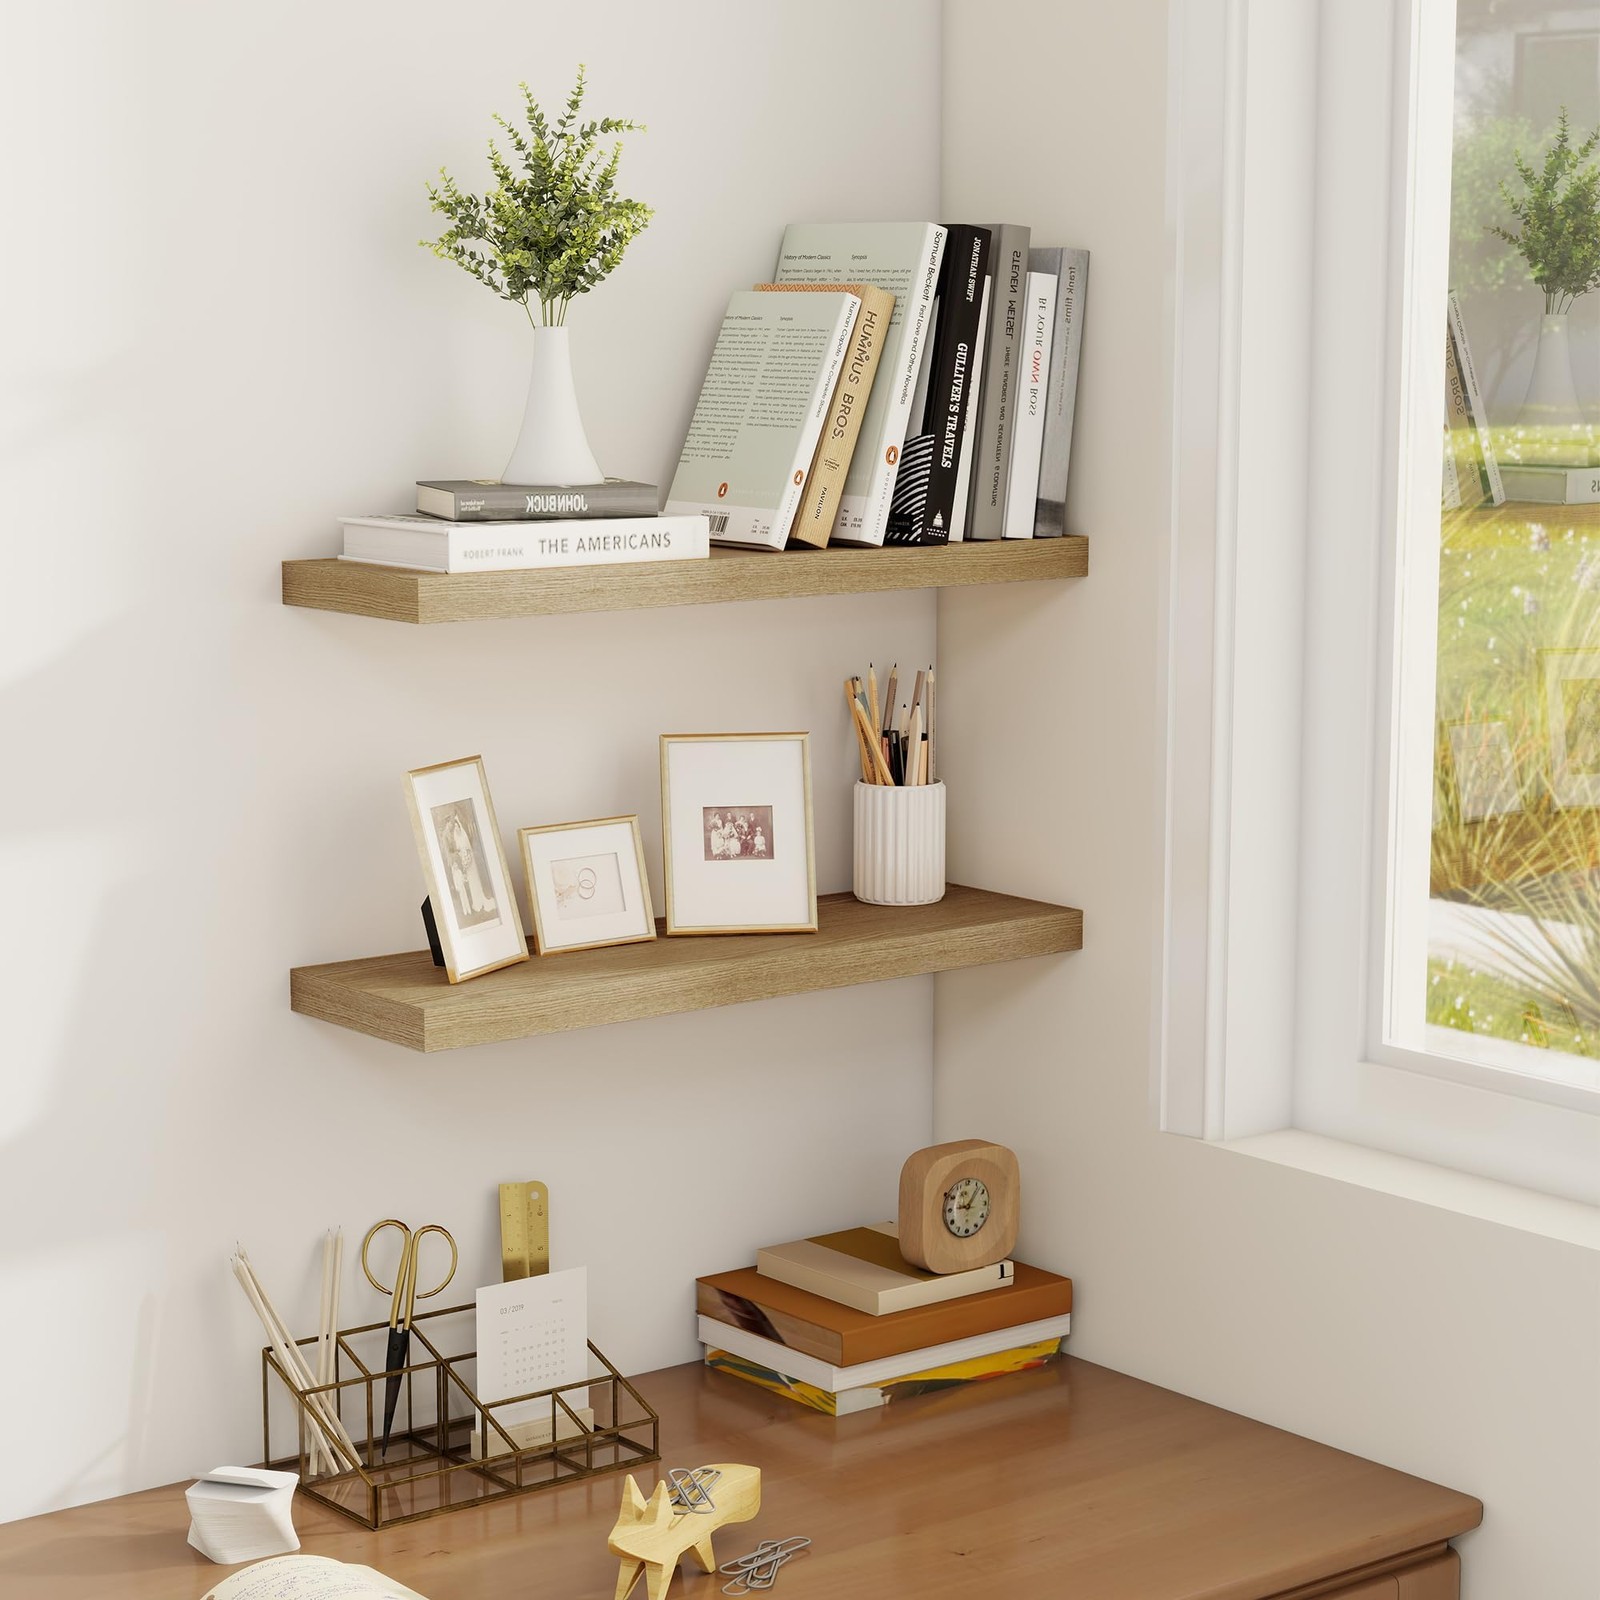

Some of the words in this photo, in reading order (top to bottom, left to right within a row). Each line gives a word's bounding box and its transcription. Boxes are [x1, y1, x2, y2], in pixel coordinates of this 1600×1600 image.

[930, 232, 942, 268] Samuel
[970, 236, 981, 278] JONATHAN
[922, 267, 936, 300] Beckett
[966, 278, 975, 302] SWIFT
[843, 301, 857, 329] Truman
[916, 314, 926, 336] Love
[836, 330, 849, 357] Capote
[848, 311, 877, 385] HUMMUS
[908, 354, 917, 373] Other
[950, 342, 969, 413] GULLIVER'S
[900, 374, 912, 405] Novellas
[831, 393, 854, 440] BROS.
[941, 414, 958, 468] TRAVELS
[815, 487, 828, 520] PAVILION
[463, 550, 494, 560] ROBERT
[497, 547, 524, 558] FRANK
[538, 538, 569, 554] THE
[576, 532, 672, 553] AMERICANS
